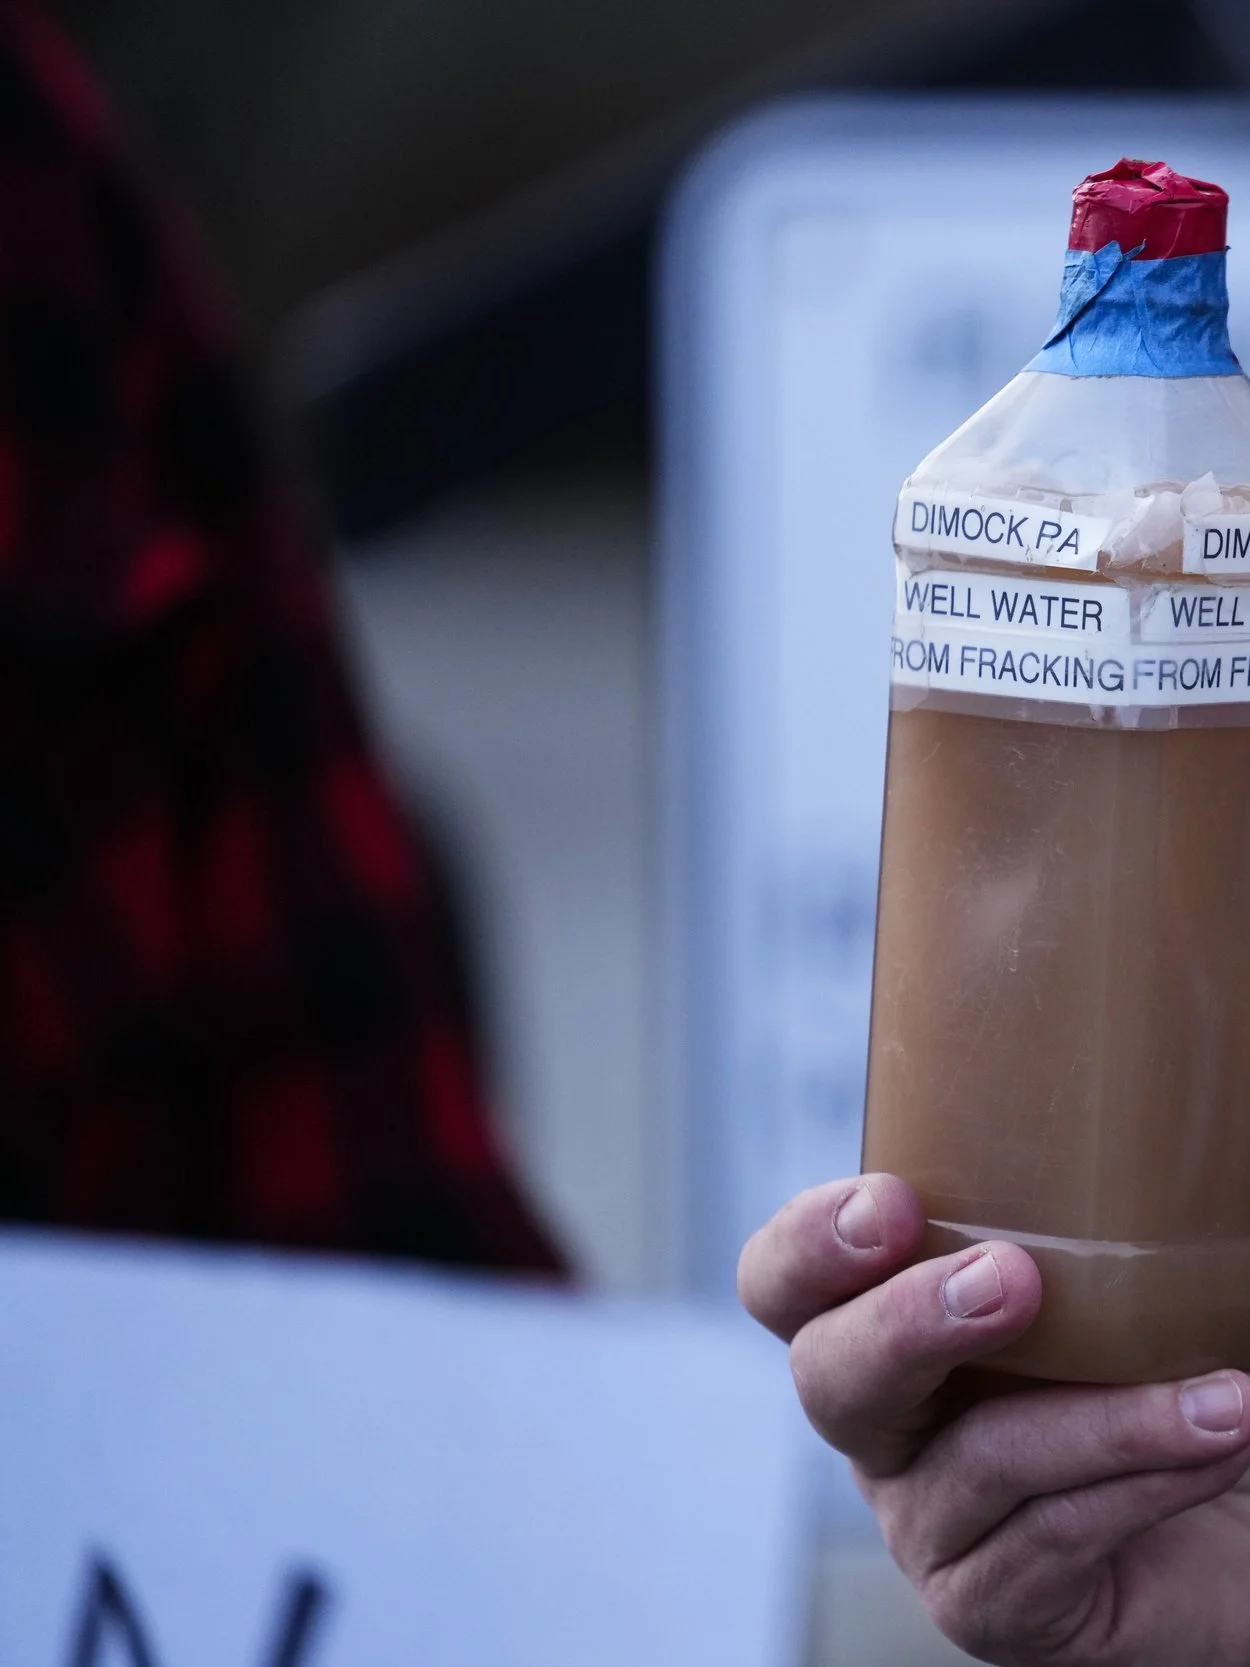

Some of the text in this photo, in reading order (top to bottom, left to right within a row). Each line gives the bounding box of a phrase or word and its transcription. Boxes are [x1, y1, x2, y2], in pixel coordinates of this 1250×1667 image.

[911, 501, 1081, 555] DIMOCK PA
[904, 580, 1103, 632] WELL WATER
[1170, 596, 1245, 628] WELL
[960, 645, 1125, 692] FRACKING
[1132, 657, 1222, 691] FROM
